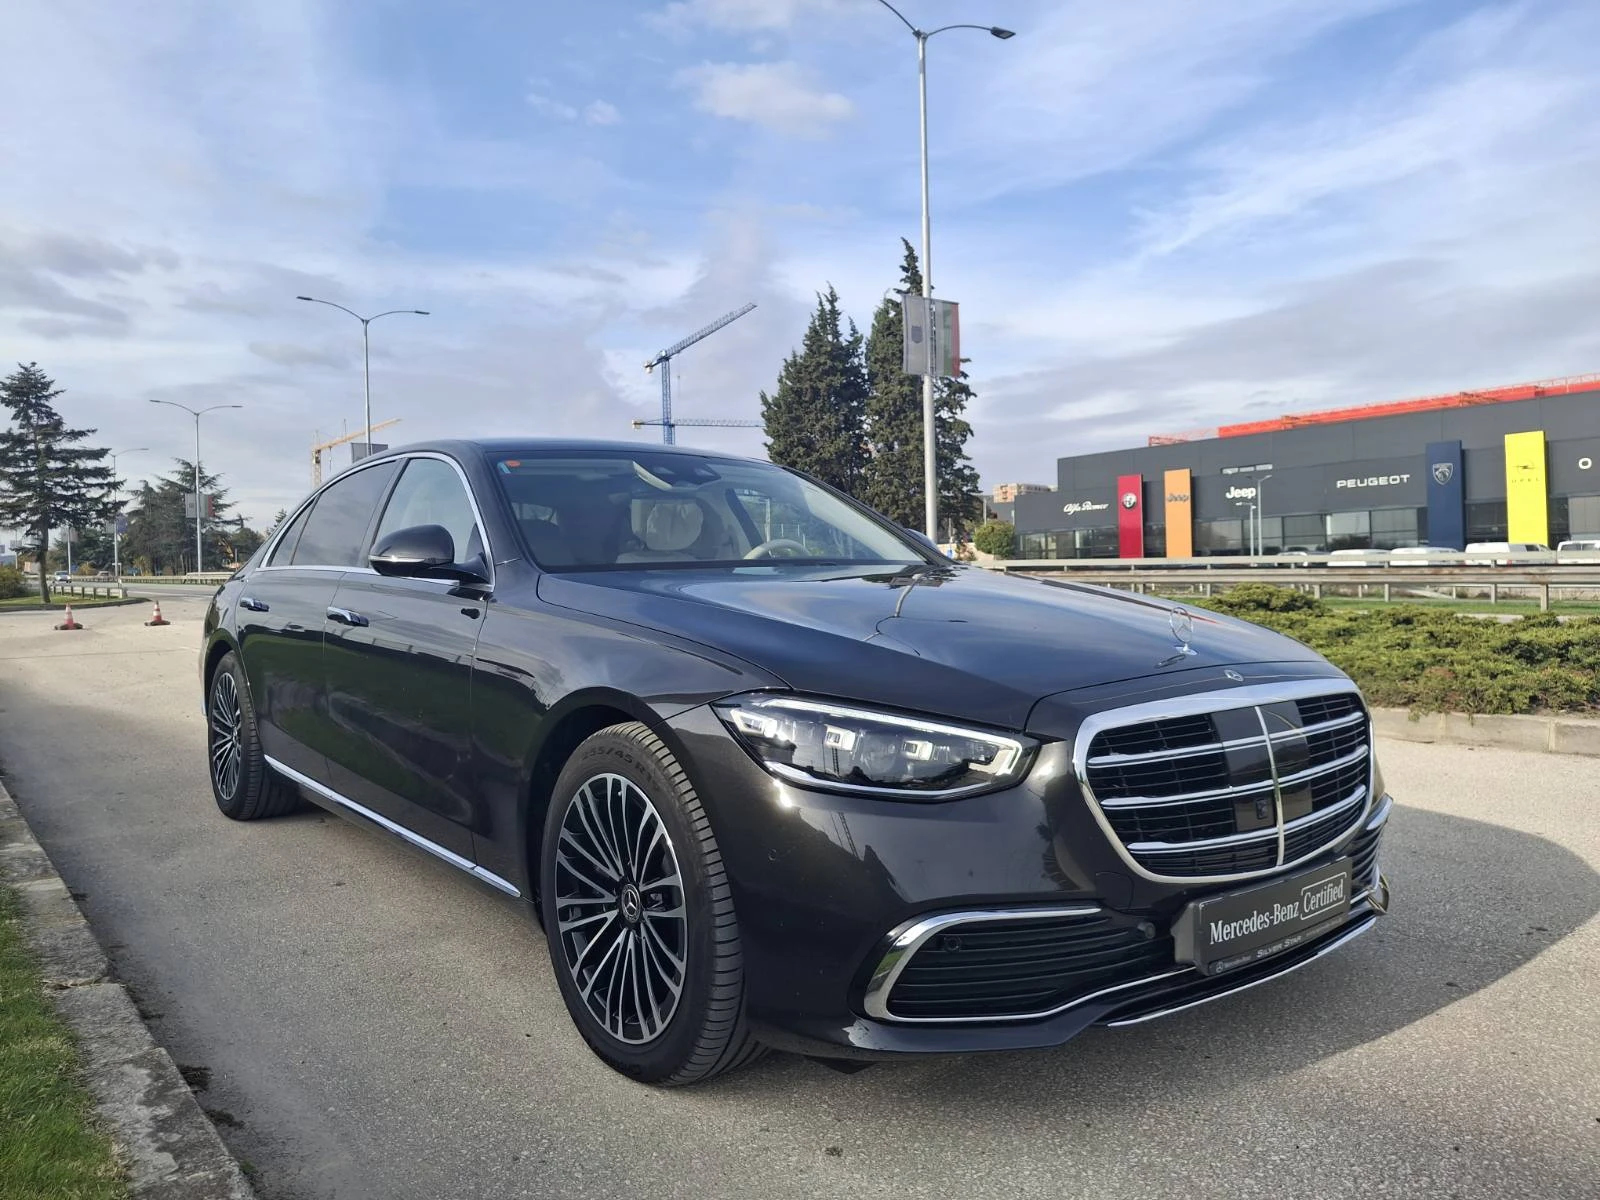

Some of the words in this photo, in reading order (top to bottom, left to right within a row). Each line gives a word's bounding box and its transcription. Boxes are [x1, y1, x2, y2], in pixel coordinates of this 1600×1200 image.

[1336, 474, 1411, 489] PEUGEOT
[1225, 486, 1257, 499] Jeep
[1209, 901, 1300, 945] Mercedes-Benz
[1303, 878, 1344, 913] Certified
